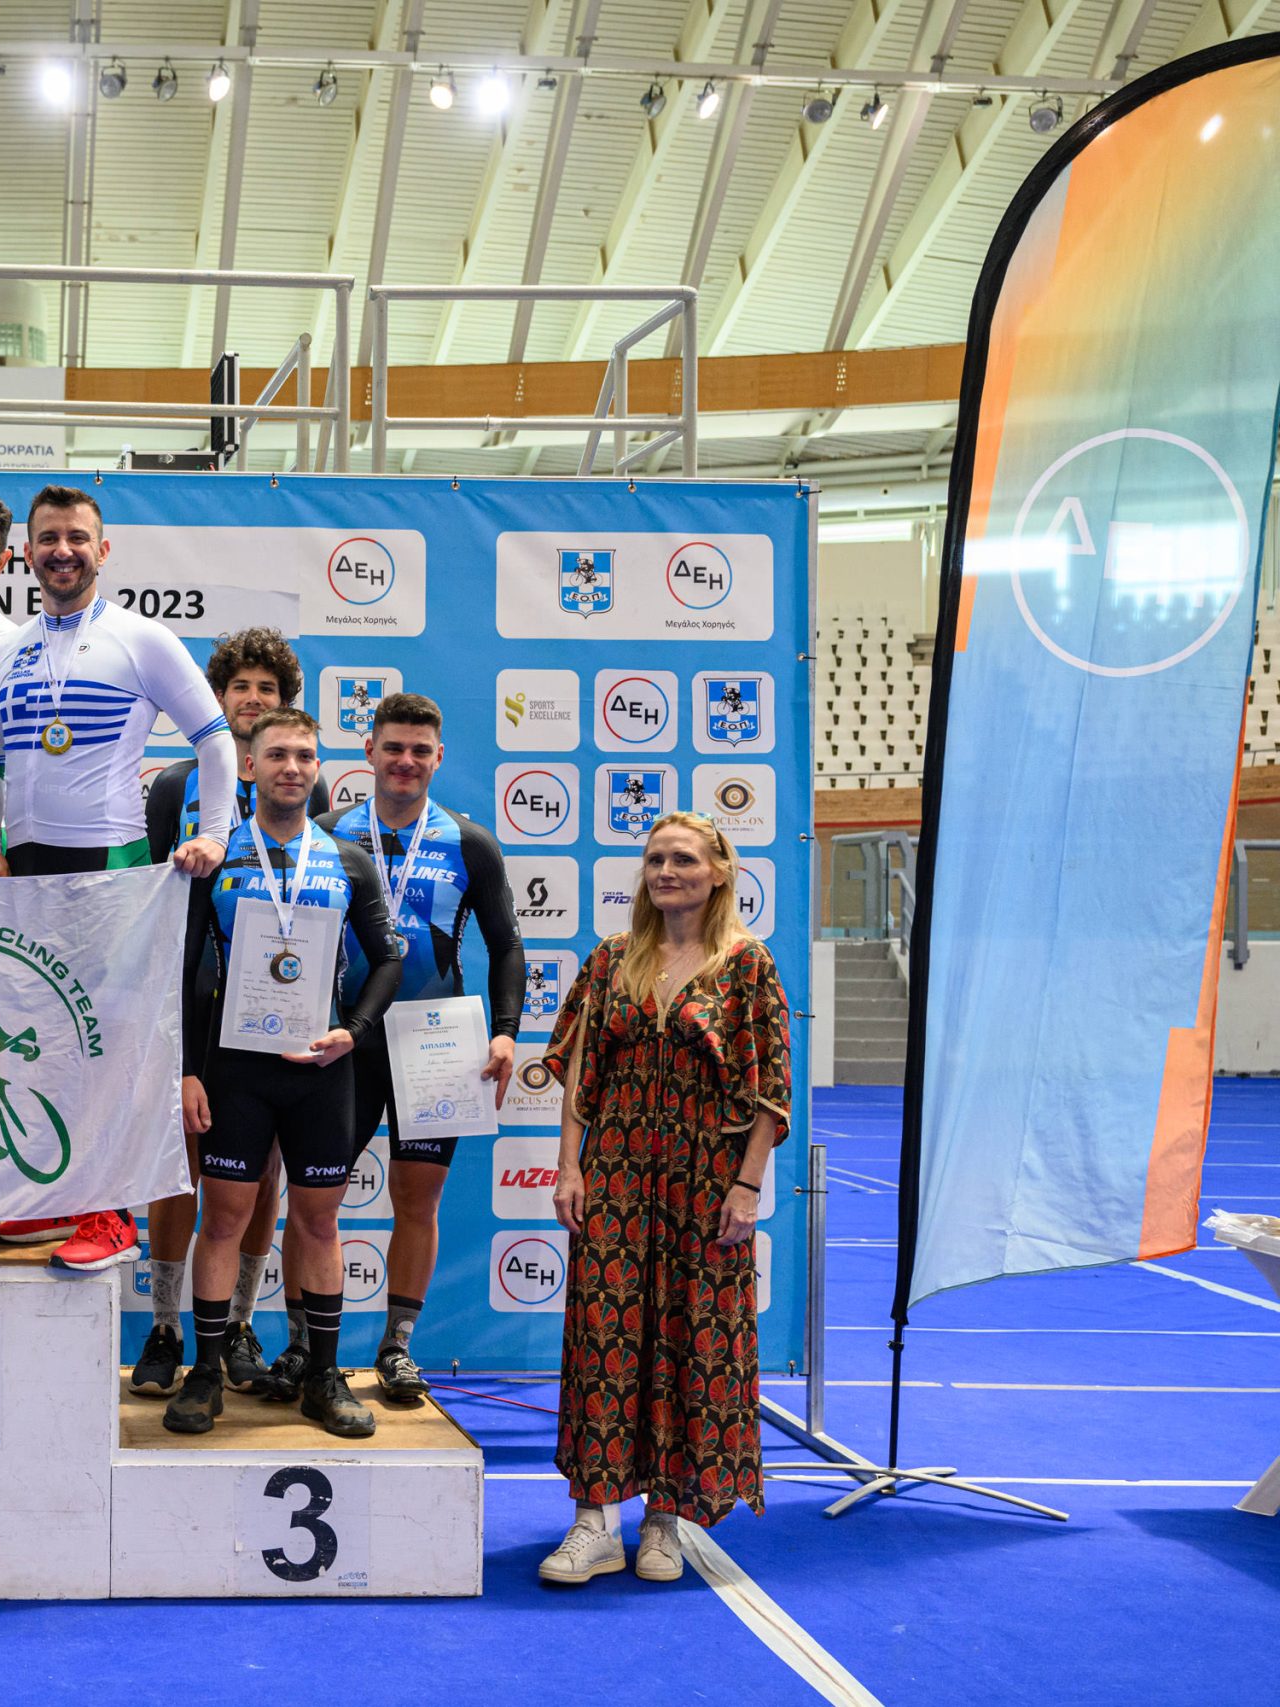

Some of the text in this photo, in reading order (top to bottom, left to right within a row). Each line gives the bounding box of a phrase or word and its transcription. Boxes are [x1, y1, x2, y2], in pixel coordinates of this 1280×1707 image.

[117, 588, 205, 620] 2023
[326, 615, 397, 626] Μεγάλος Χορηγός
[665, 620, 735, 629] Μεγάλος Χορηγός
[529, 701, 555, 709] SPORTS
[529, 711, 571, 720] EXCELLENCE
[68, 979, 104, 1058] TEAM
[507, 1097, 542, 1105] FOCUS
[400, 1141, 441, 1153] SYNKA
[205, 1154, 246, 1170] SYNKA
[305, 1165, 346, 1176] SYNKA
[344, 1263, 376, 1284] ΕΗ
[261, 1466, 338, 1582] 3
